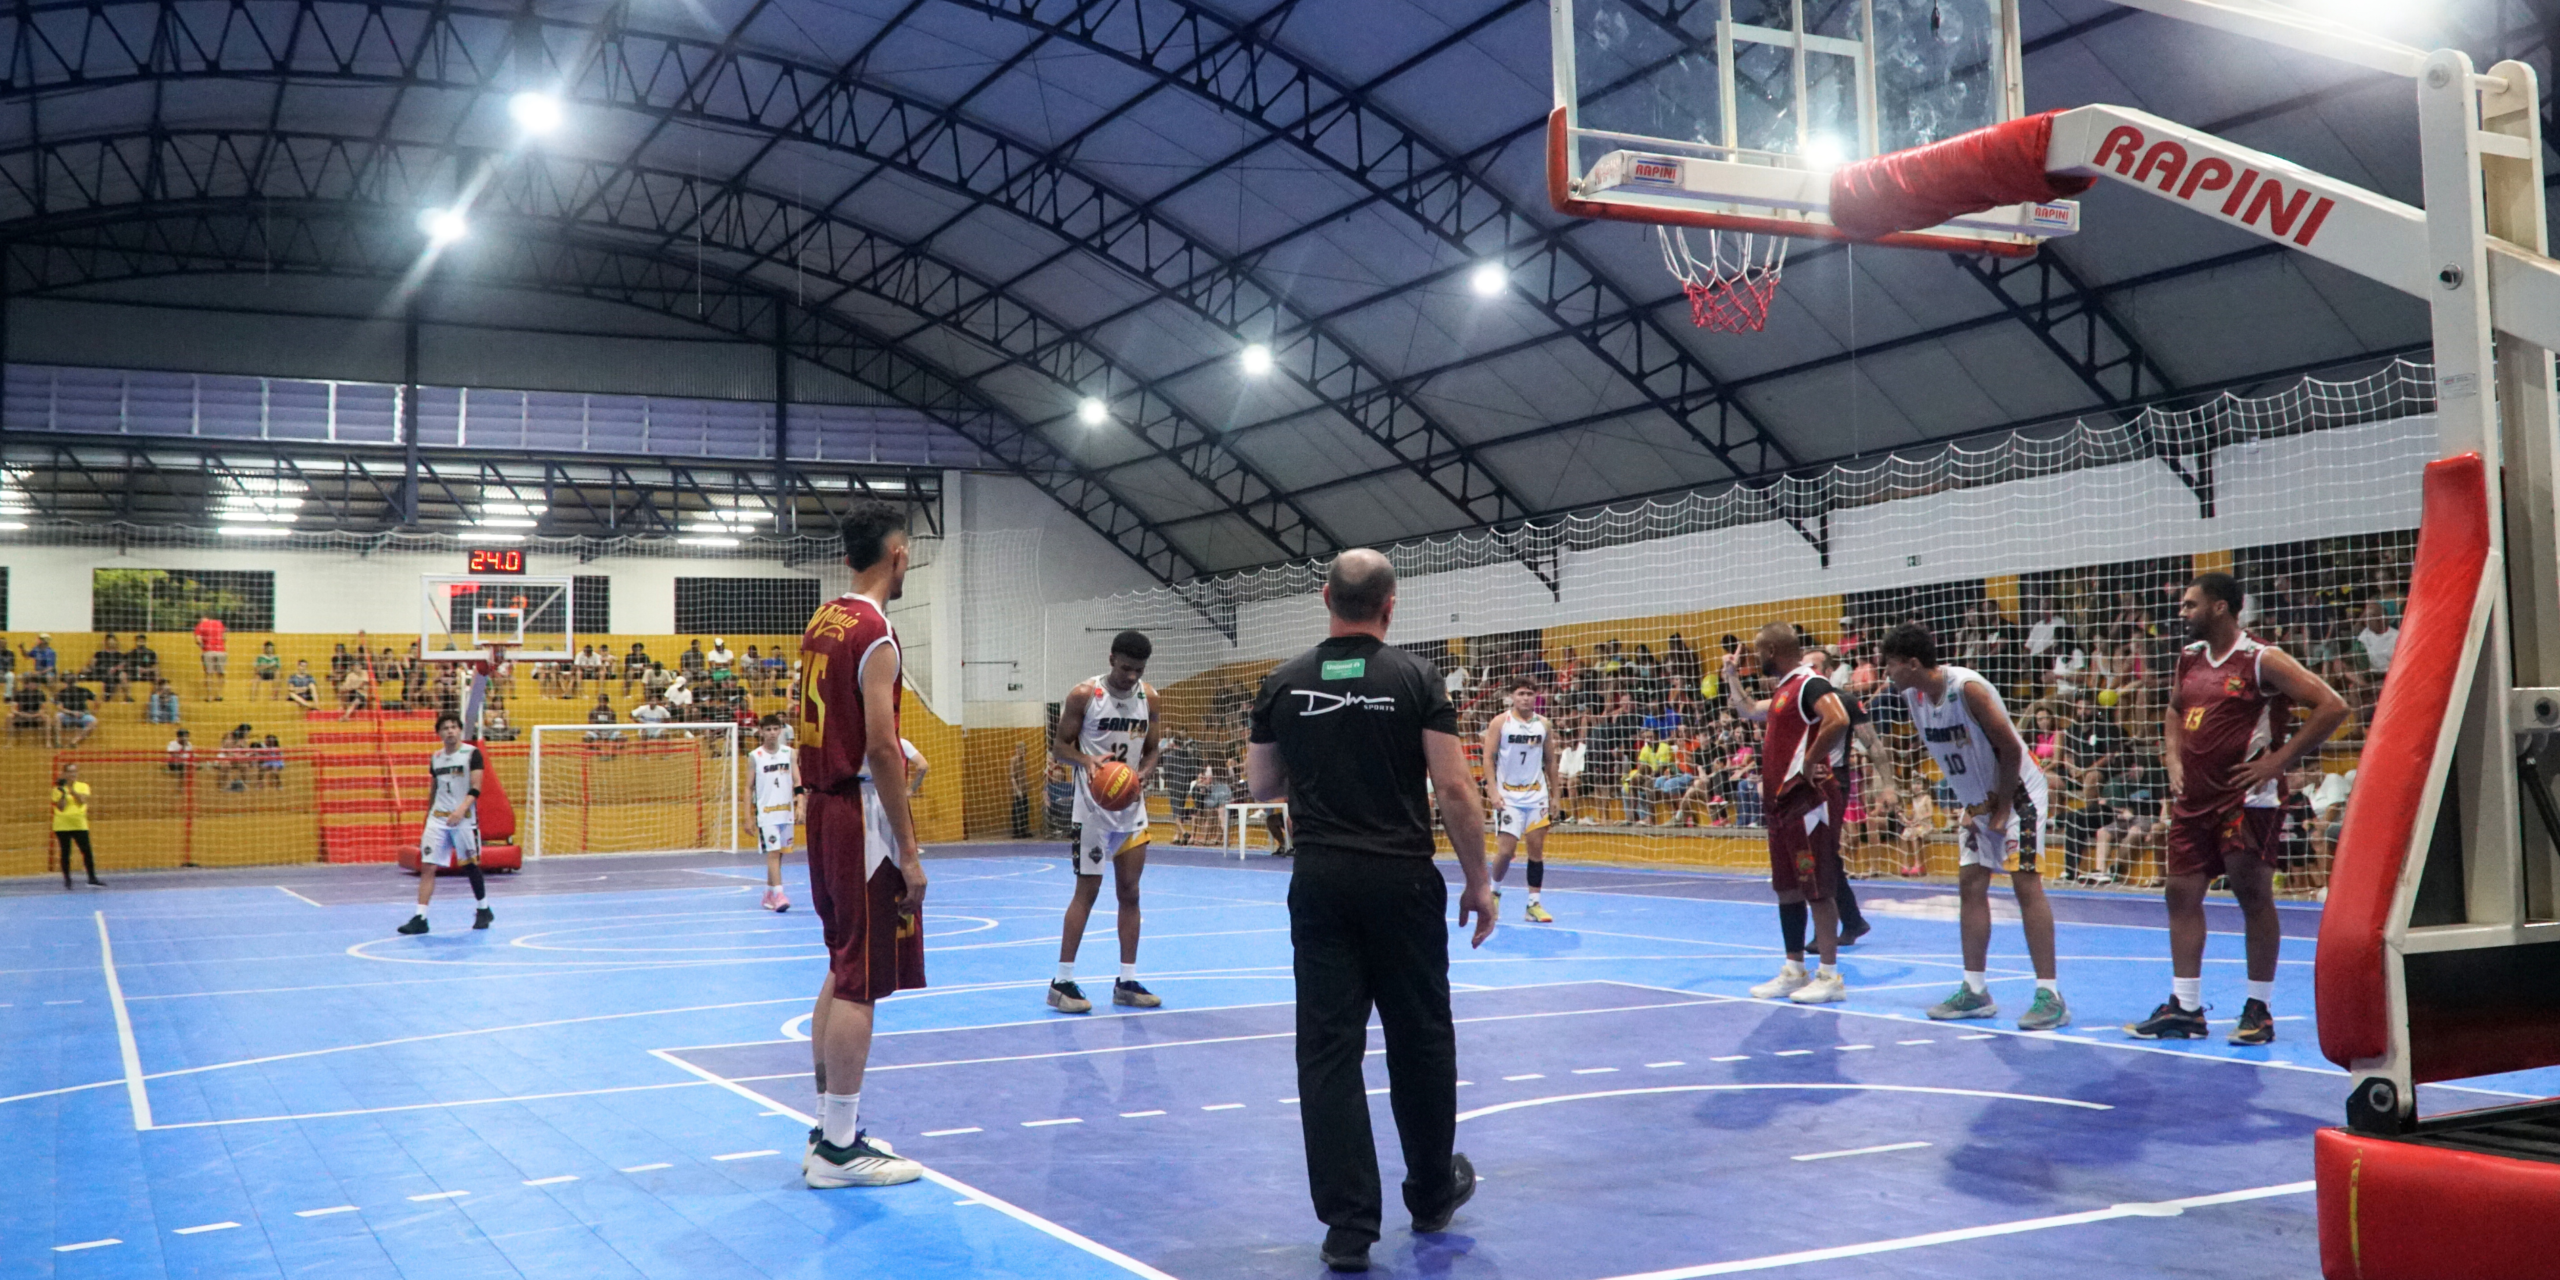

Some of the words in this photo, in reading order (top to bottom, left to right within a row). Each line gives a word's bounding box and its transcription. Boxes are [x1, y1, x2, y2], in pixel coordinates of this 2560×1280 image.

[1635, 164, 1677, 180] RAPINI
[2092, 125, 2336, 247] RAPINI
[2035, 206, 2069, 220] RAPINI
[471, 550, 521, 571] 24.0
[800, 651, 829, 748] 15
[1363, 704, 1395, 712] SPORTS
[2185, 707, 2206, 731] 13
[1109, 742, 1128, 763] 12
[1520, 752, 1527, 765] 7
[1944, 753, 1967, 776] 10
[774, 777, 780, 788] 4
